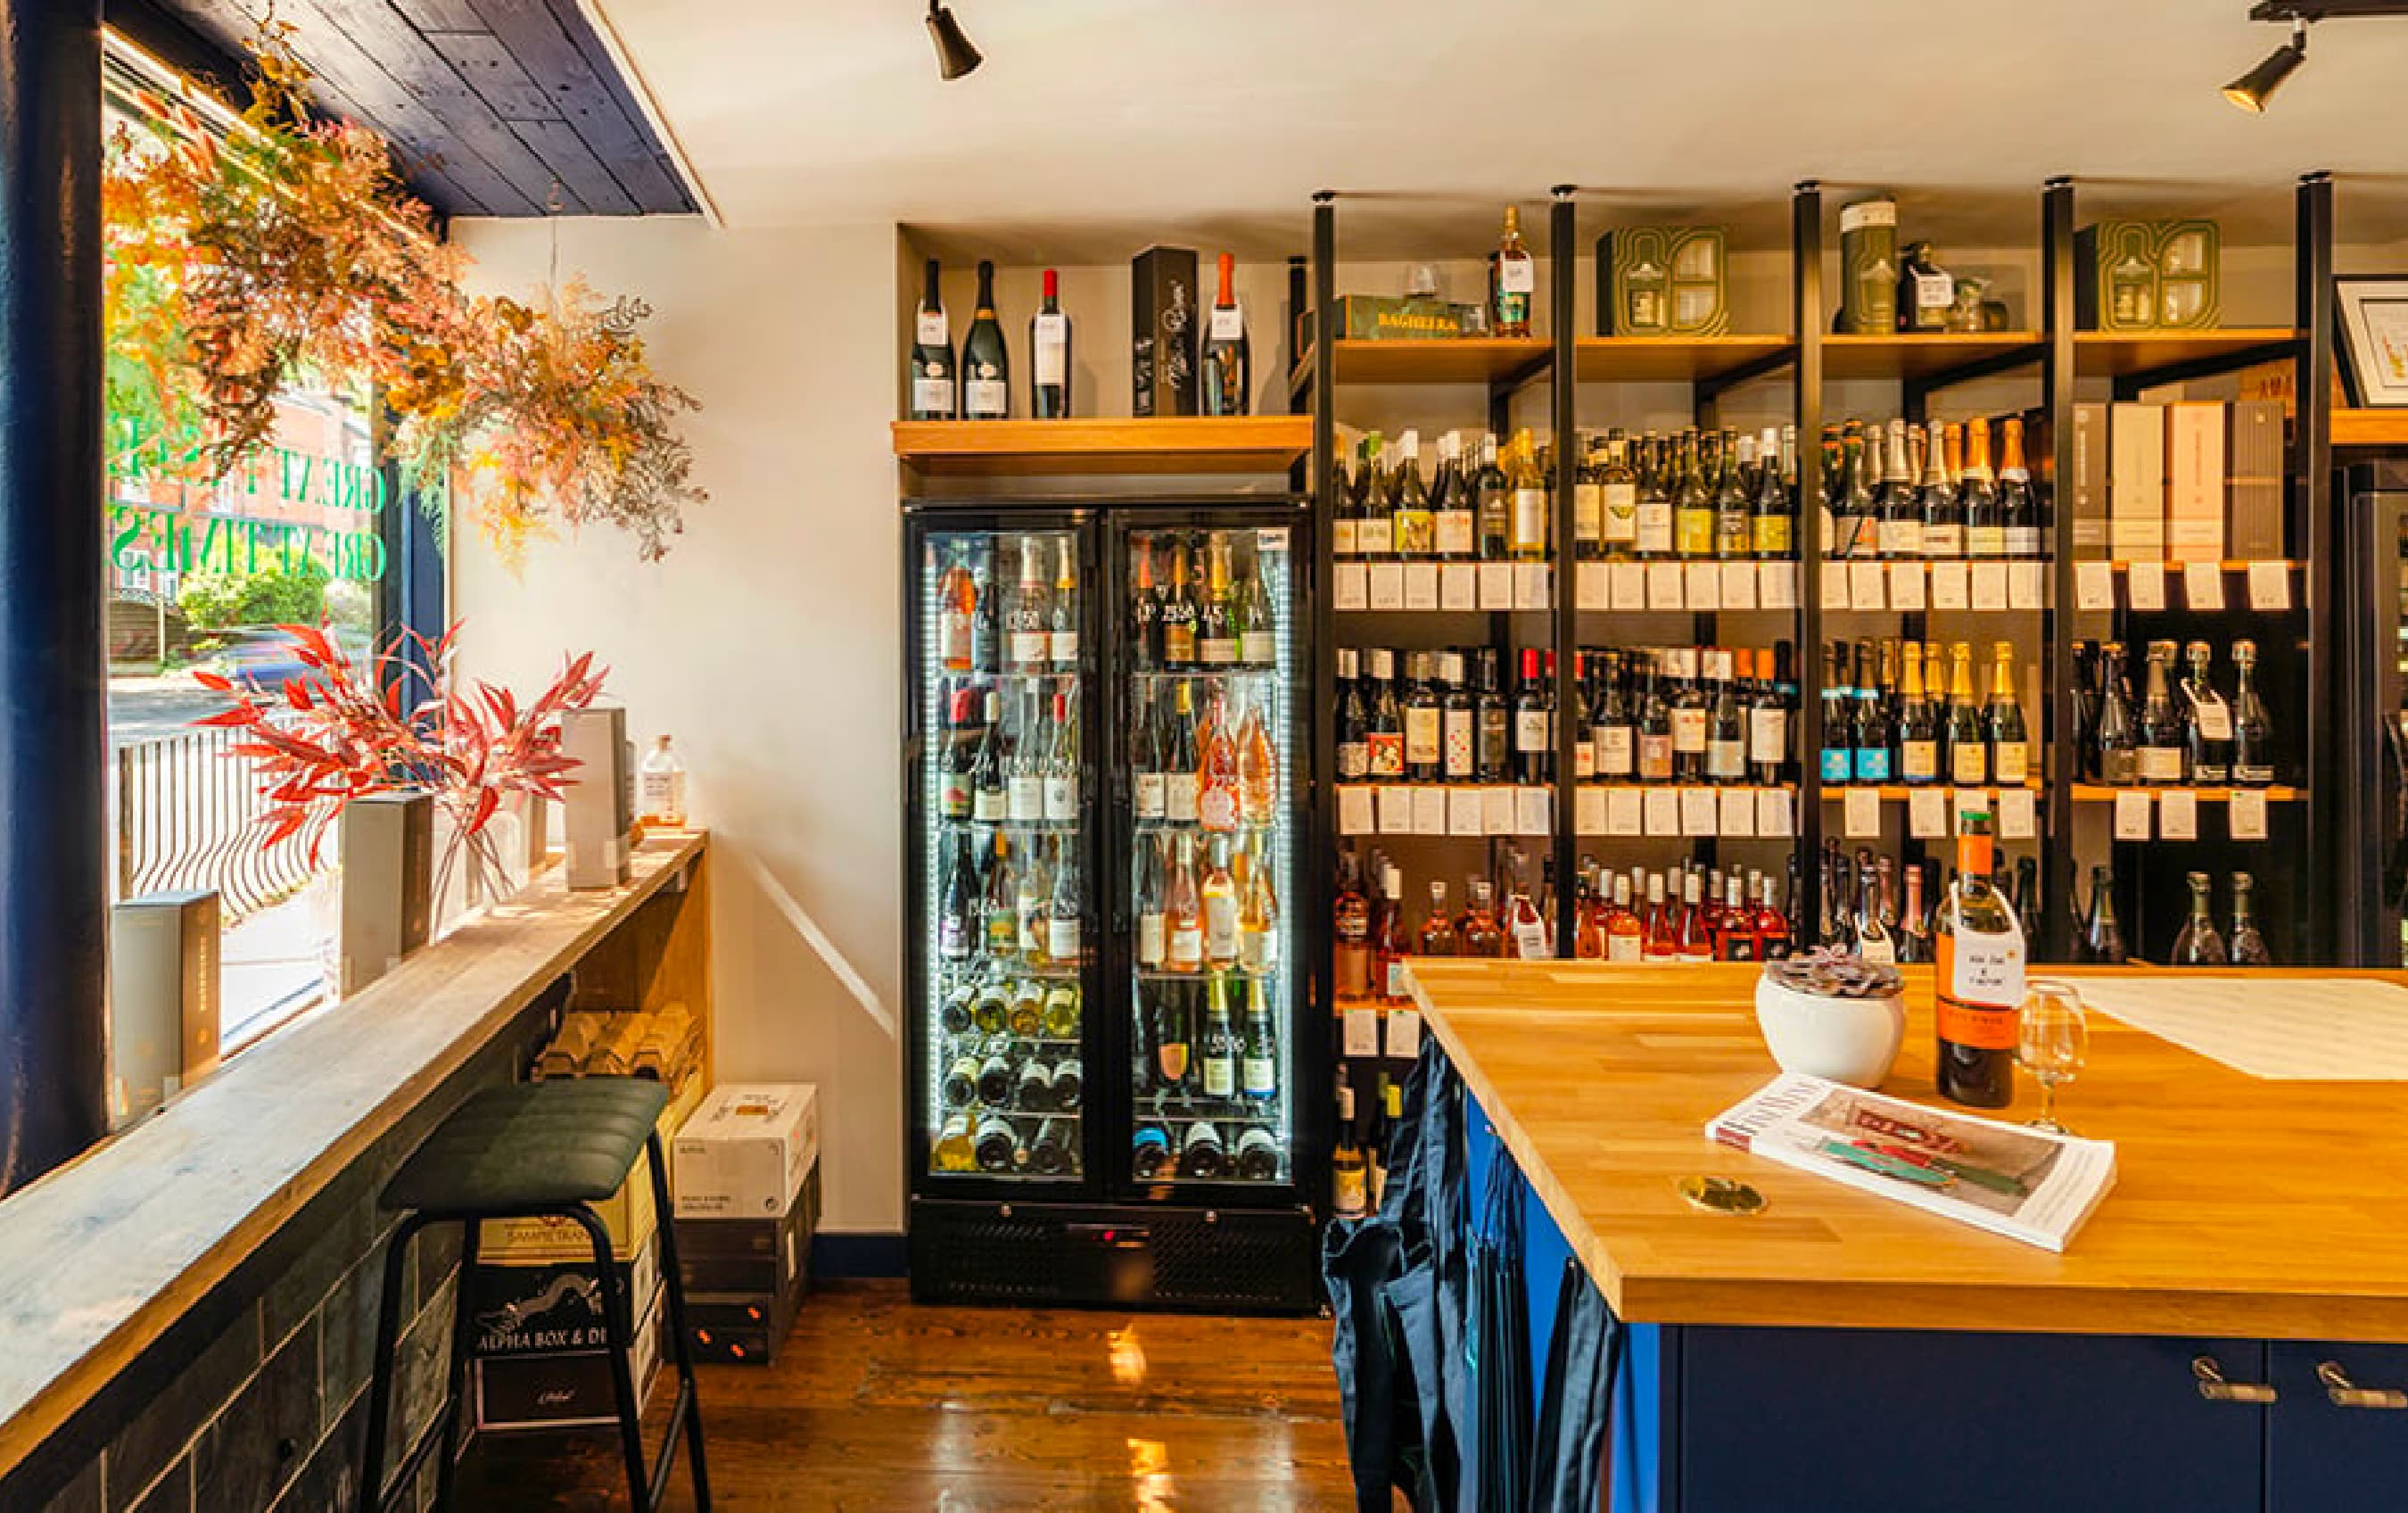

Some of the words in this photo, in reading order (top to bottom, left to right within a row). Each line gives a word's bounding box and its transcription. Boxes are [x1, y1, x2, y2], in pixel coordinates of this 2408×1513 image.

[477, 1331, 531, 1352] ALPHA
[534, 1329, 566, 1349] BOX
[588, 1327, 607, 1344] DI
